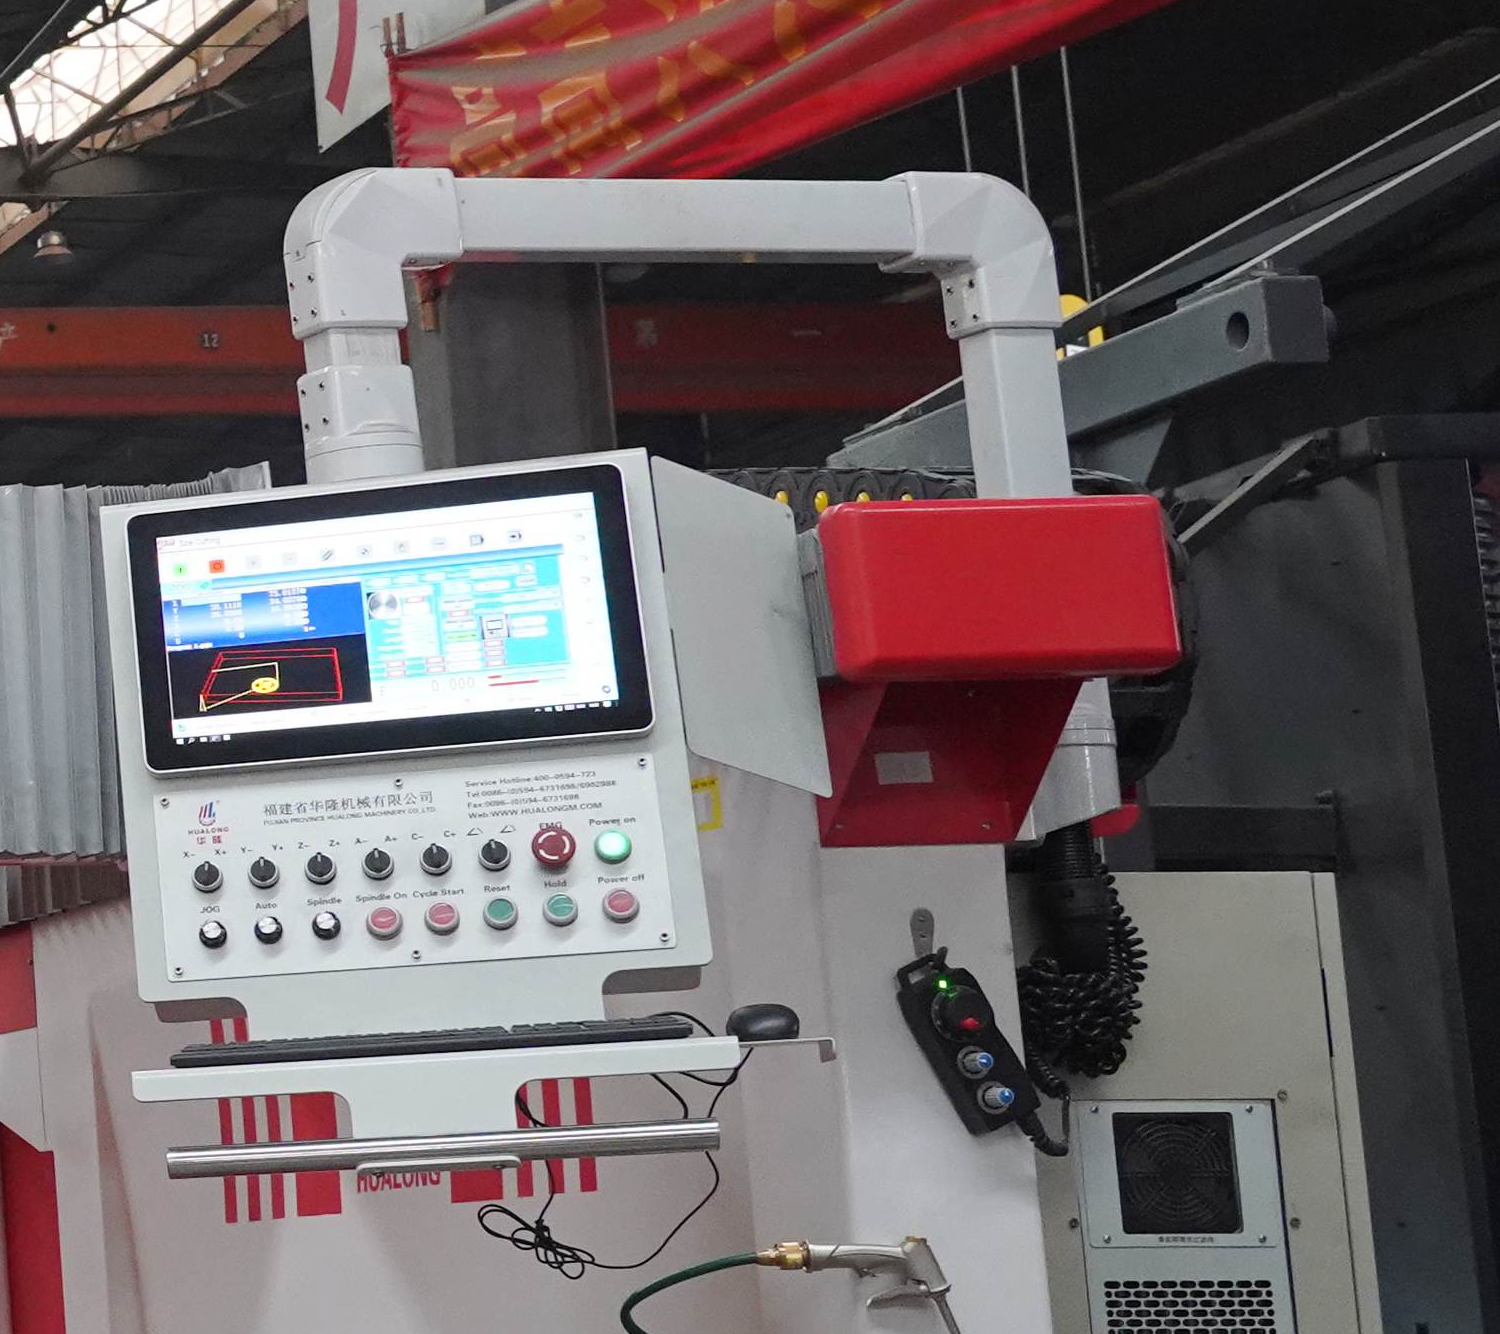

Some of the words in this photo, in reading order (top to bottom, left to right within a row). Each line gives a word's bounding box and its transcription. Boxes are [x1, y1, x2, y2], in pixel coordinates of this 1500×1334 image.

[263, 790, 434, 817] 福建省华隆机械有限公司
[588, 818, 619, 826] Power
[622, 816, 636, 824] on
[188, 826, 230, 836] HUALONG
[544, 879, 567, 888] Hold
[597, 875, 629, 884] Power
[632, 873, 645, 882] off
[412, 890, 439, 899] Cycle
[441, 887, 464, 896] Start
[484, 884, 511, 893] Reset
[307, 897, 342, 906] Spindle
[355, 893, 391, 903] Spindle
[393, 891, 407, 899] On
[199, 905, 221, 914] JOG
[255, 901, 278, 910] Auto
